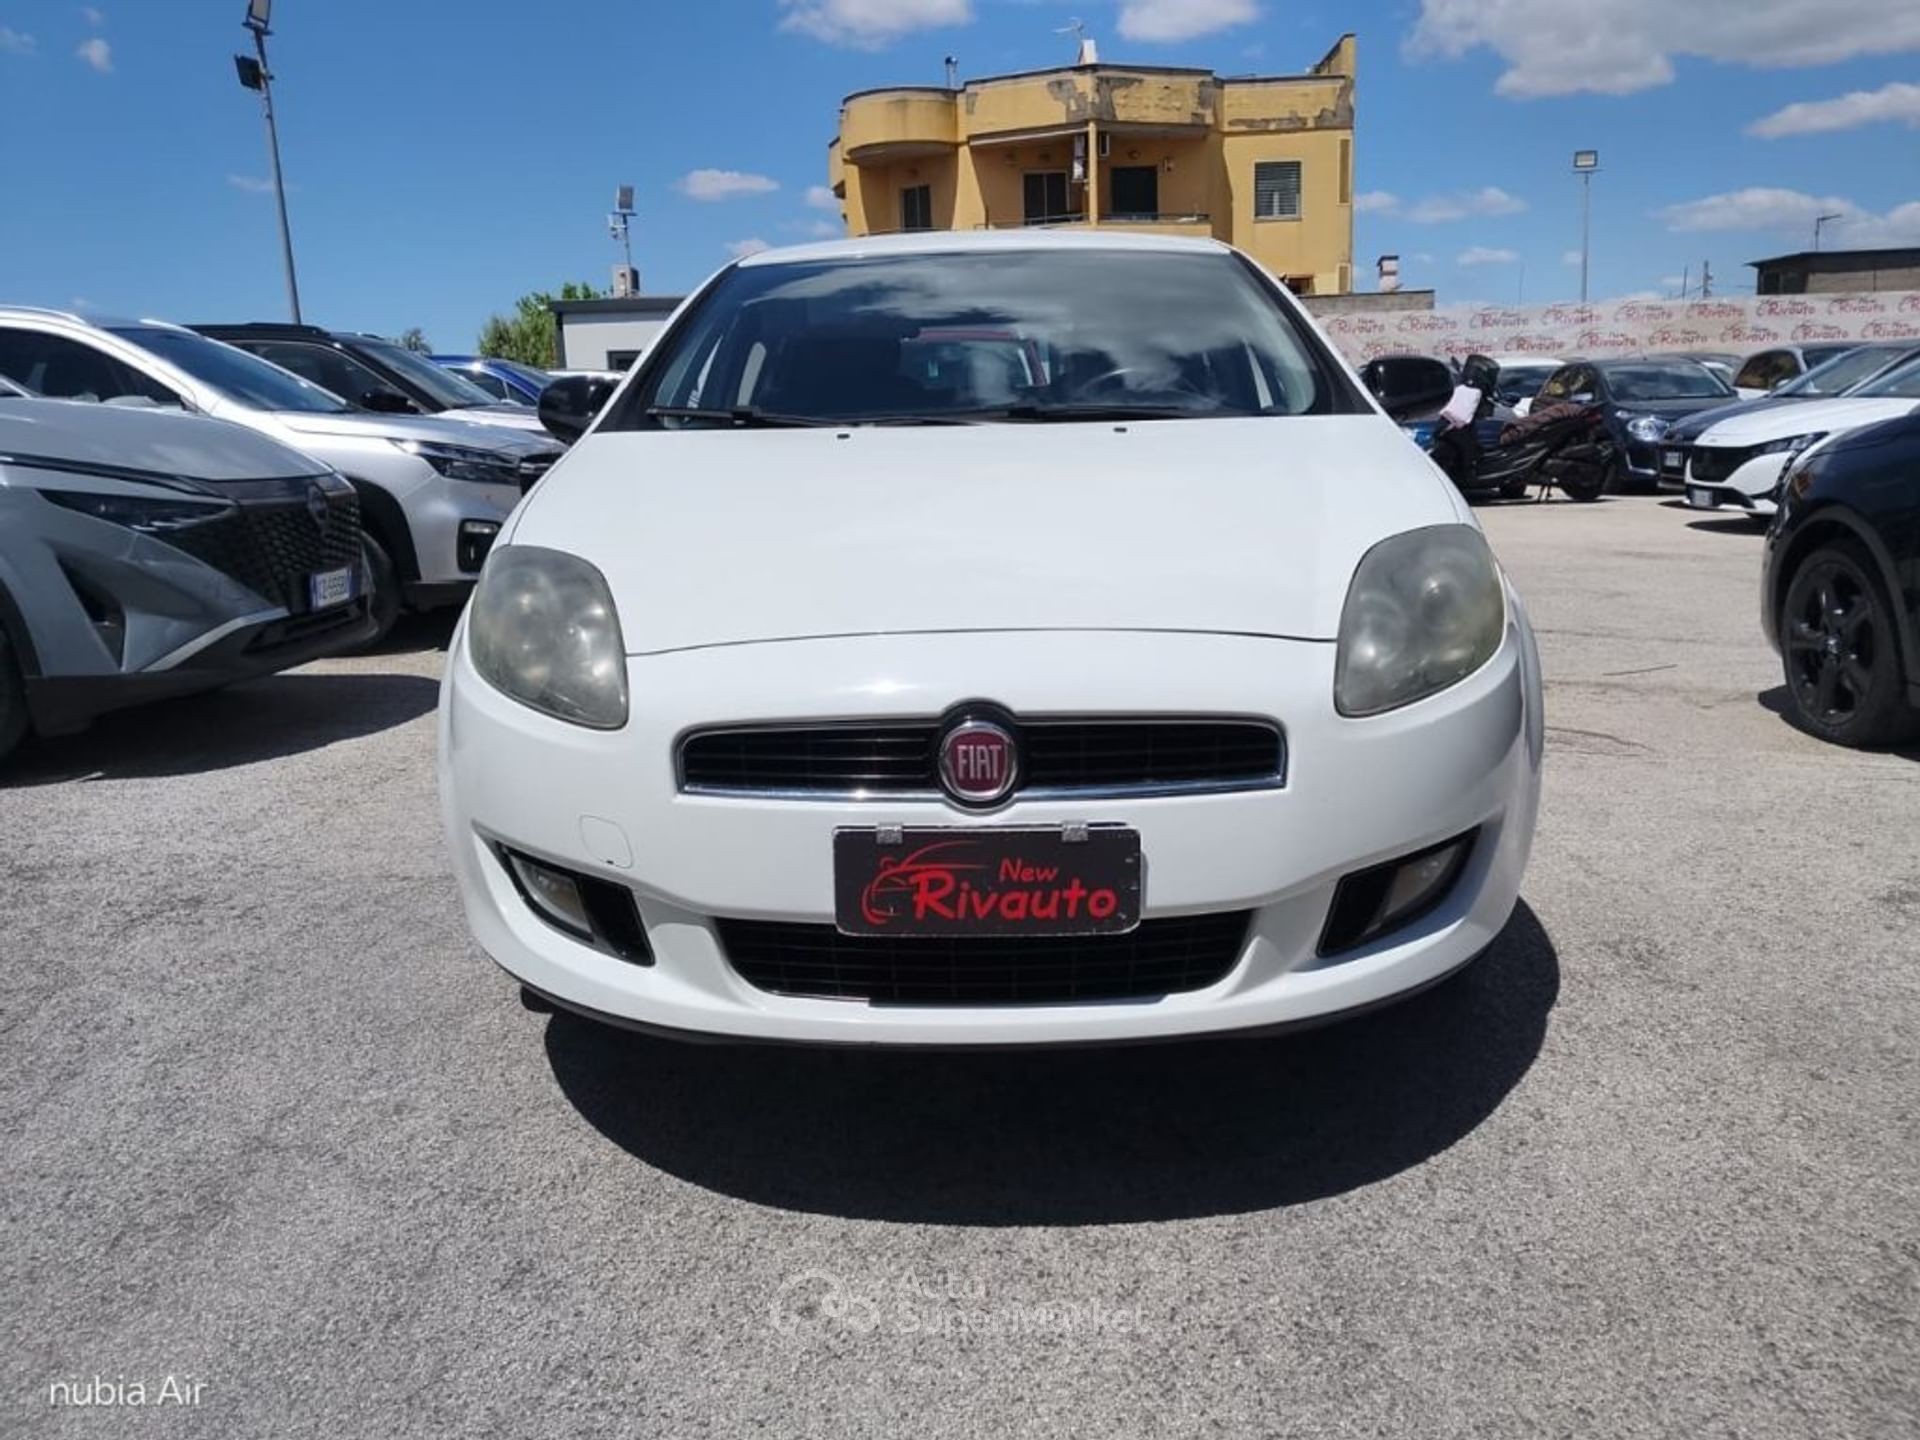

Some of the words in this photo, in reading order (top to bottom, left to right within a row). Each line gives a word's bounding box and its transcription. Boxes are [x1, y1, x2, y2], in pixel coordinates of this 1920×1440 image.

[957, 744, 1002, 780] FIAT
[1000, 858, 1058, 883] New
[910, 869, 1117, 921] Rivauto
